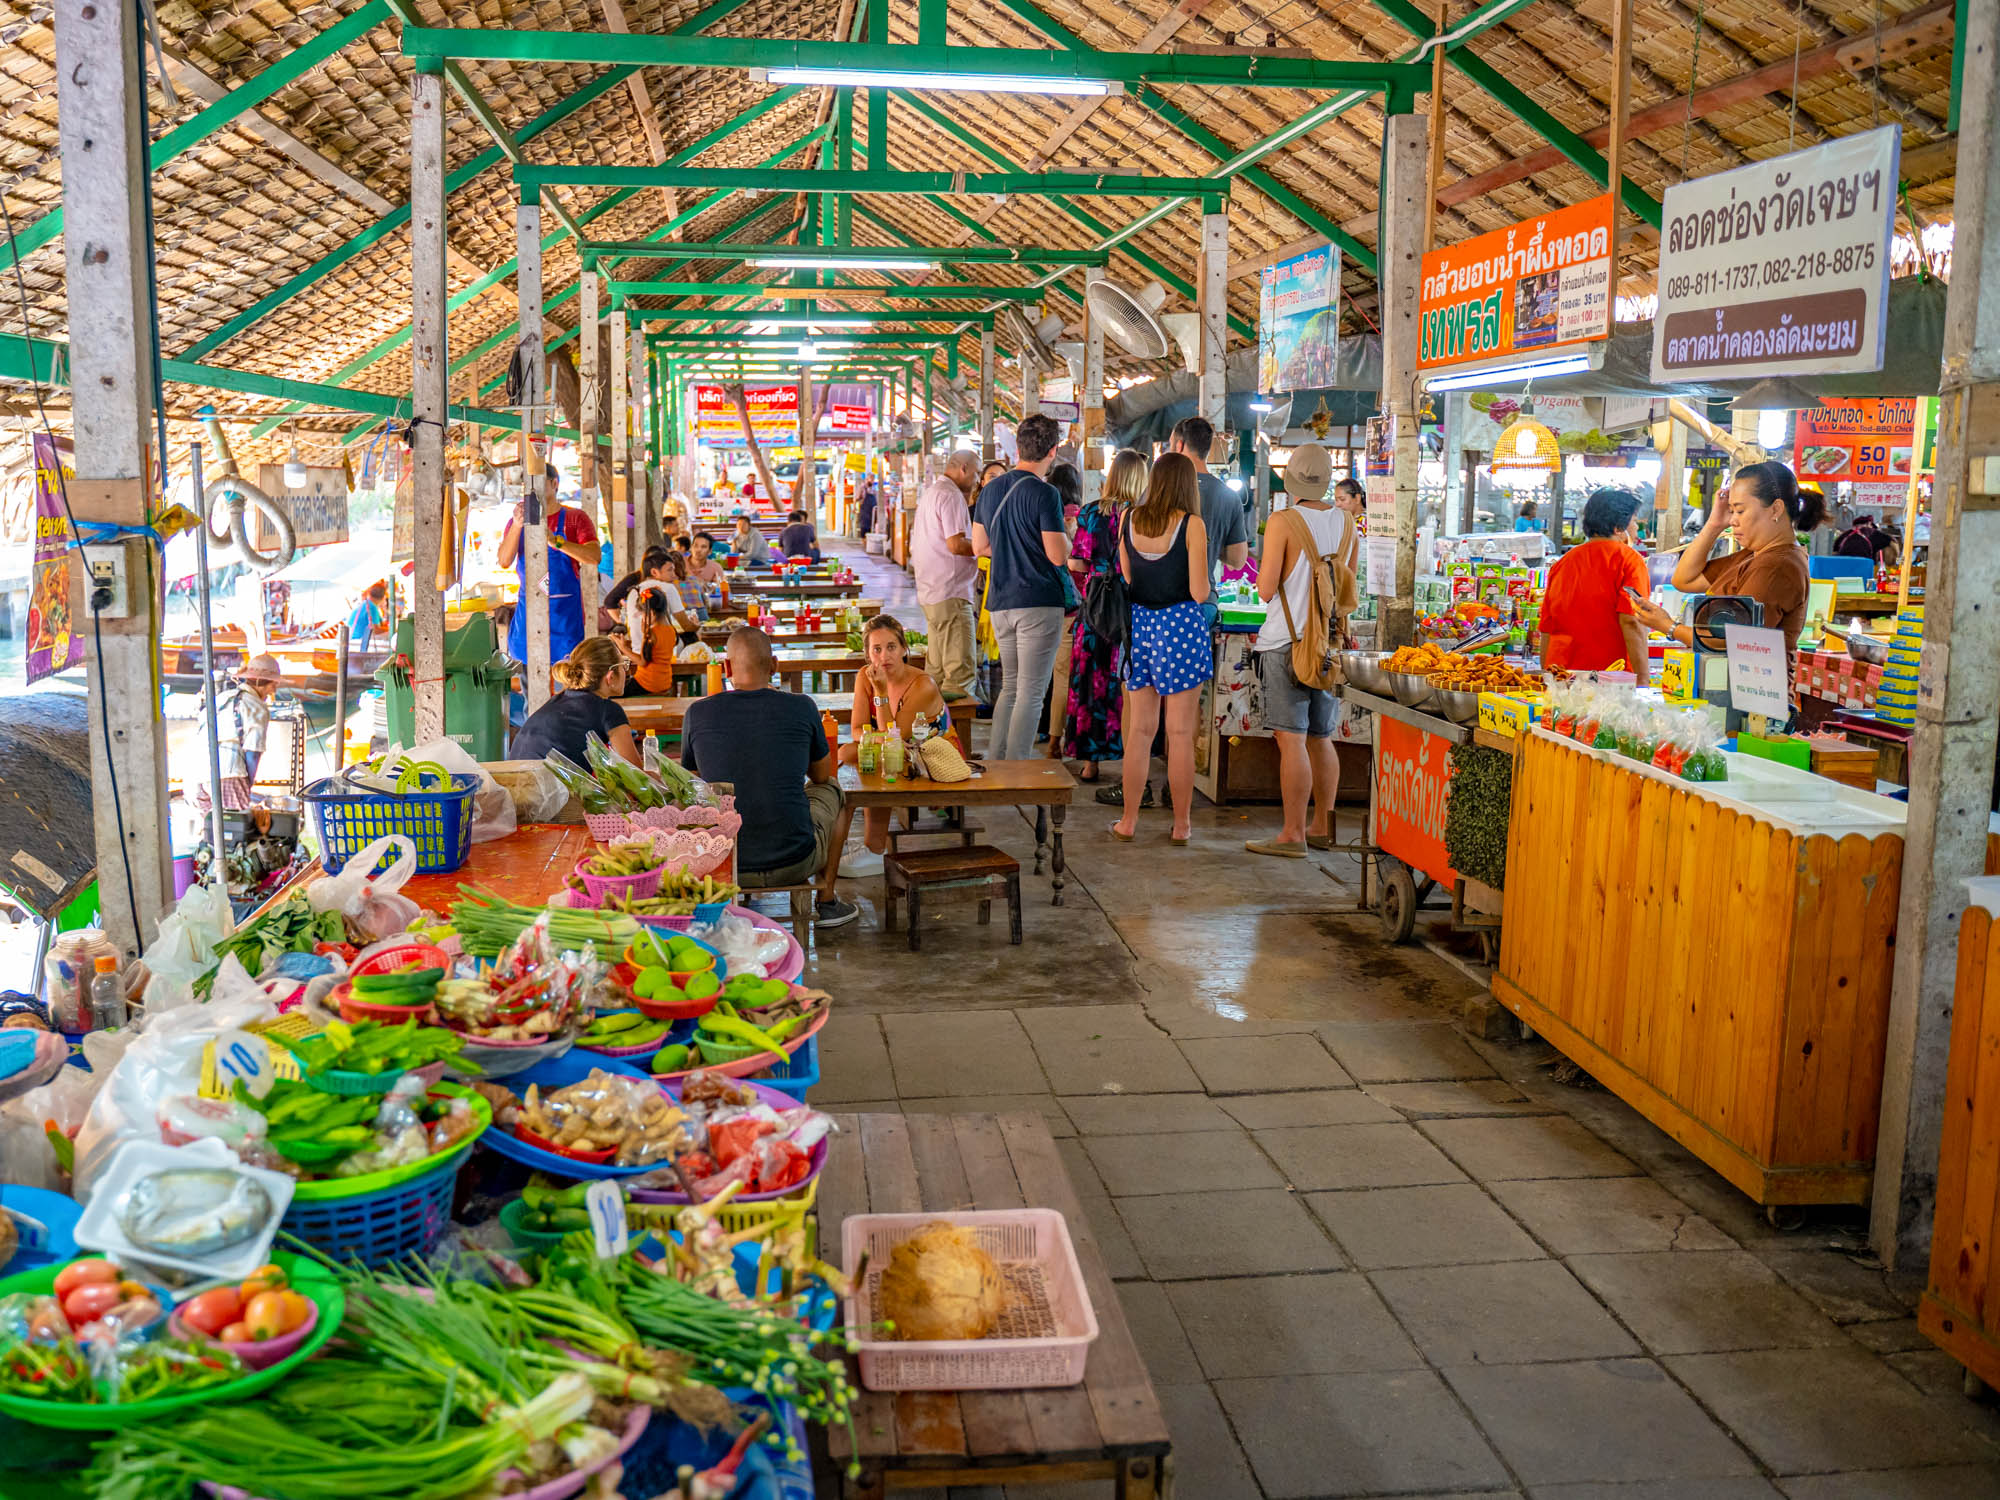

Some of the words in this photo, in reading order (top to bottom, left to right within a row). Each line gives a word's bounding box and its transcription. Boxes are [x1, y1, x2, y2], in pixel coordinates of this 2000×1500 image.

[1669, 169, 1881, 254] ลอดช่องวัดเจษฯ
[1423, 221, 1608, 301] กล้วยอบน้ำผึ้งทอด
[1421, 288, 1503, 361] เทพรส
[1582, 309, 1593, 322] 100
[1667, 309, 1857, 363] ตลาดน้ำคลองลัดมะยม
[1532, 394, 1583, 410] Organic
[1856, 465, 1884, 475] บาท
[1859, 446, 1885, 462] 50
[221, 1042, 260, 1077] 10
